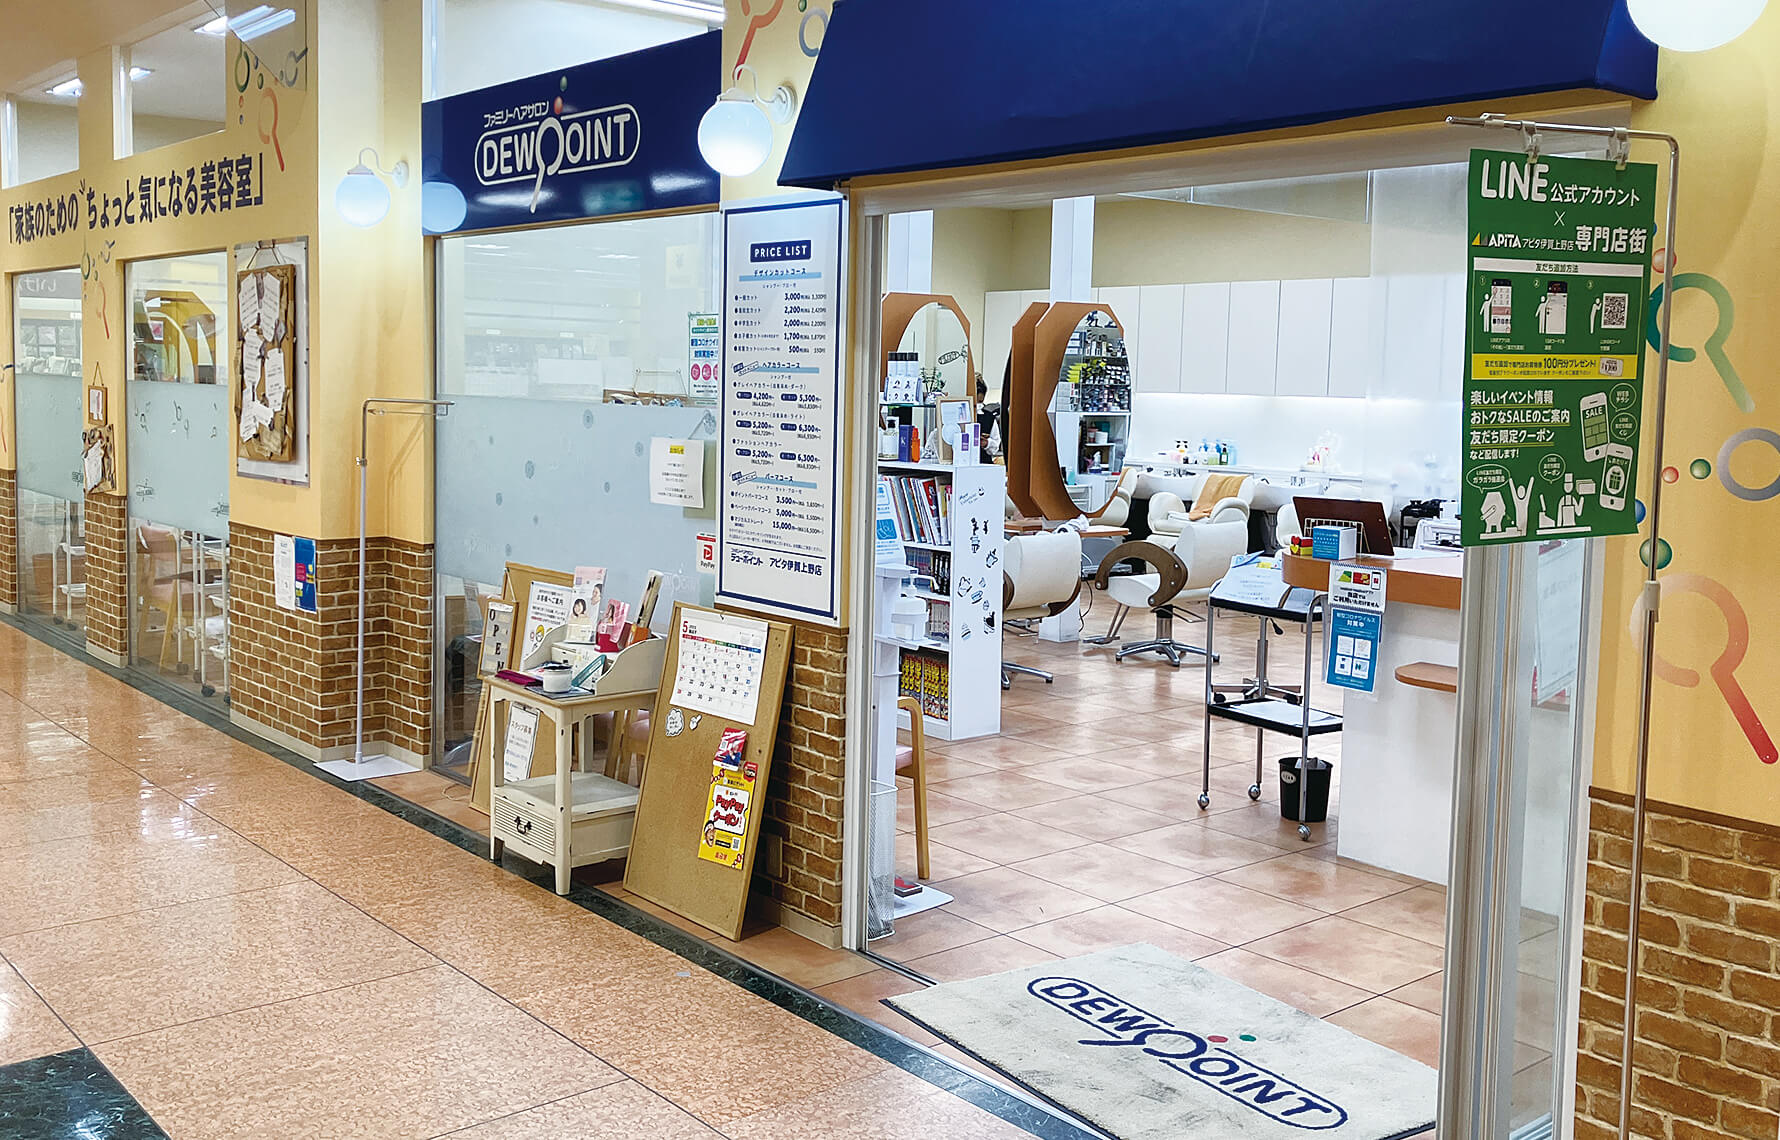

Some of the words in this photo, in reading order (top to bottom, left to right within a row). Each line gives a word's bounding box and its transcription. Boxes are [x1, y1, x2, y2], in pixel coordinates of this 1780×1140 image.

[484, 101, 550, 128] ファミリーヘアサロン
[1481, 158, 1550, 202] LINE
[1550, 182, 1640, 207] 公式アカウント
[1522, 238, 1574, 251] アピタ伊賀上野店
[1576, 225, 1648, 254] 専門店街
[754, 246, 782, 258] PRICE
[785, 245, 808, 256] LIST
[1536, 263, 1578, 273] 友だち追加方法
[1470, 390, 1554, 405] 楽しいイベント情報
[1470, 410, 1570, 424] おトクなSALEのご案内
[1585, 408, 1603, 418] SALE
[1470, 429, 1555, 445] 友だち限定クーポン
[1470, 449, 1519, 460] など配信します!
[731, 553, 764, 566] デューポイント
[769, 557, 822, 576] アピタ伊賀上野店
[1333, 596, 1379, 608] ご利用いただけません
[716, 795, 744, 814] PayPay
